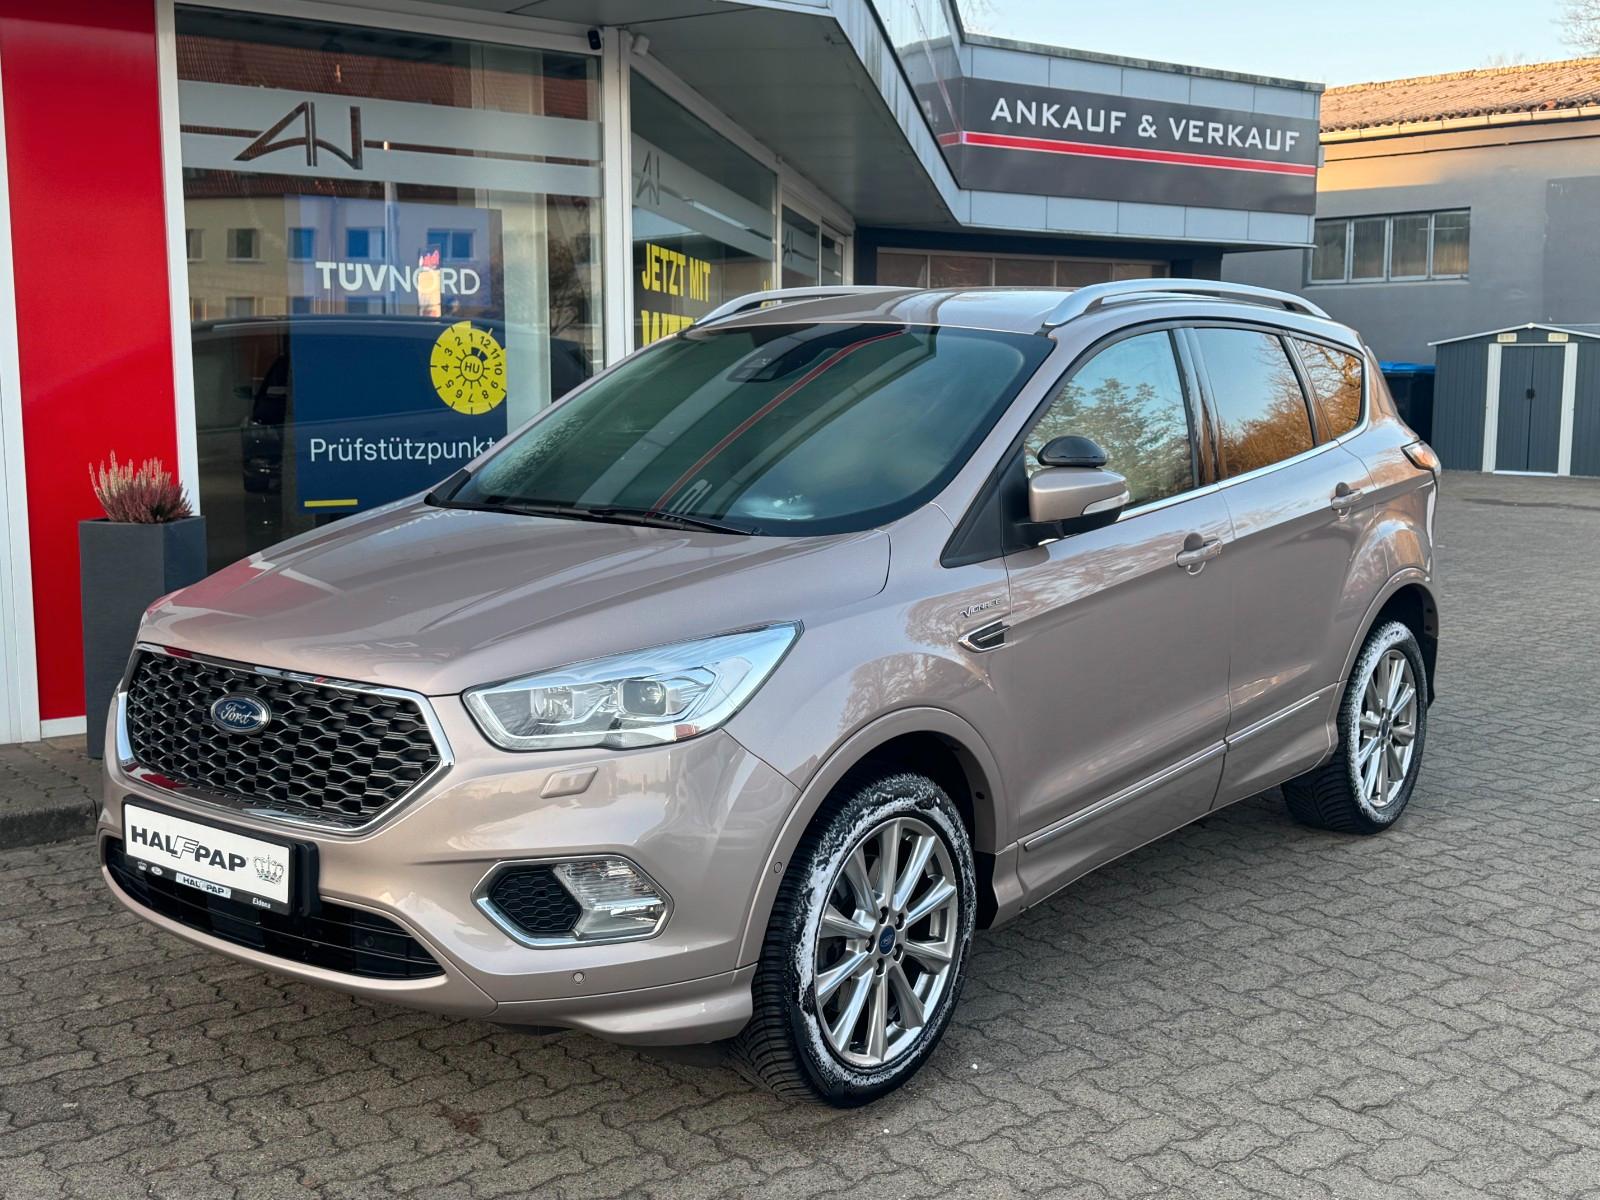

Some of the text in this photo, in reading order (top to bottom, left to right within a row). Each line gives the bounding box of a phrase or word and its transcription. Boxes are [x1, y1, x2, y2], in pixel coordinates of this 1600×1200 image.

[991, 98, 1300, 152] ANKAUF & VERKAUF
[642, 242, 711, 303] JETZT MIT
[455, 336, 463, 346] 2
[468, 333, 473, 342] 1
[480, 336, 491, 349] 12
[444, 348, 453, 356] 3
[491, 348, 500, 360] 11
[441, 364, 449, 372] 4
[464, 362, 480, 374] HU
[494, 362, 503, 376] 10
[445, 379, 454, 389] 5
[468, 393, 474, 403] 7
[481, 390, 489, 399] 8
[310, 436, 495, 466] Prüfstützpunkt
[221, 702, 255, 724] Ford
[131, 825, 247, 872] HALFPAP
